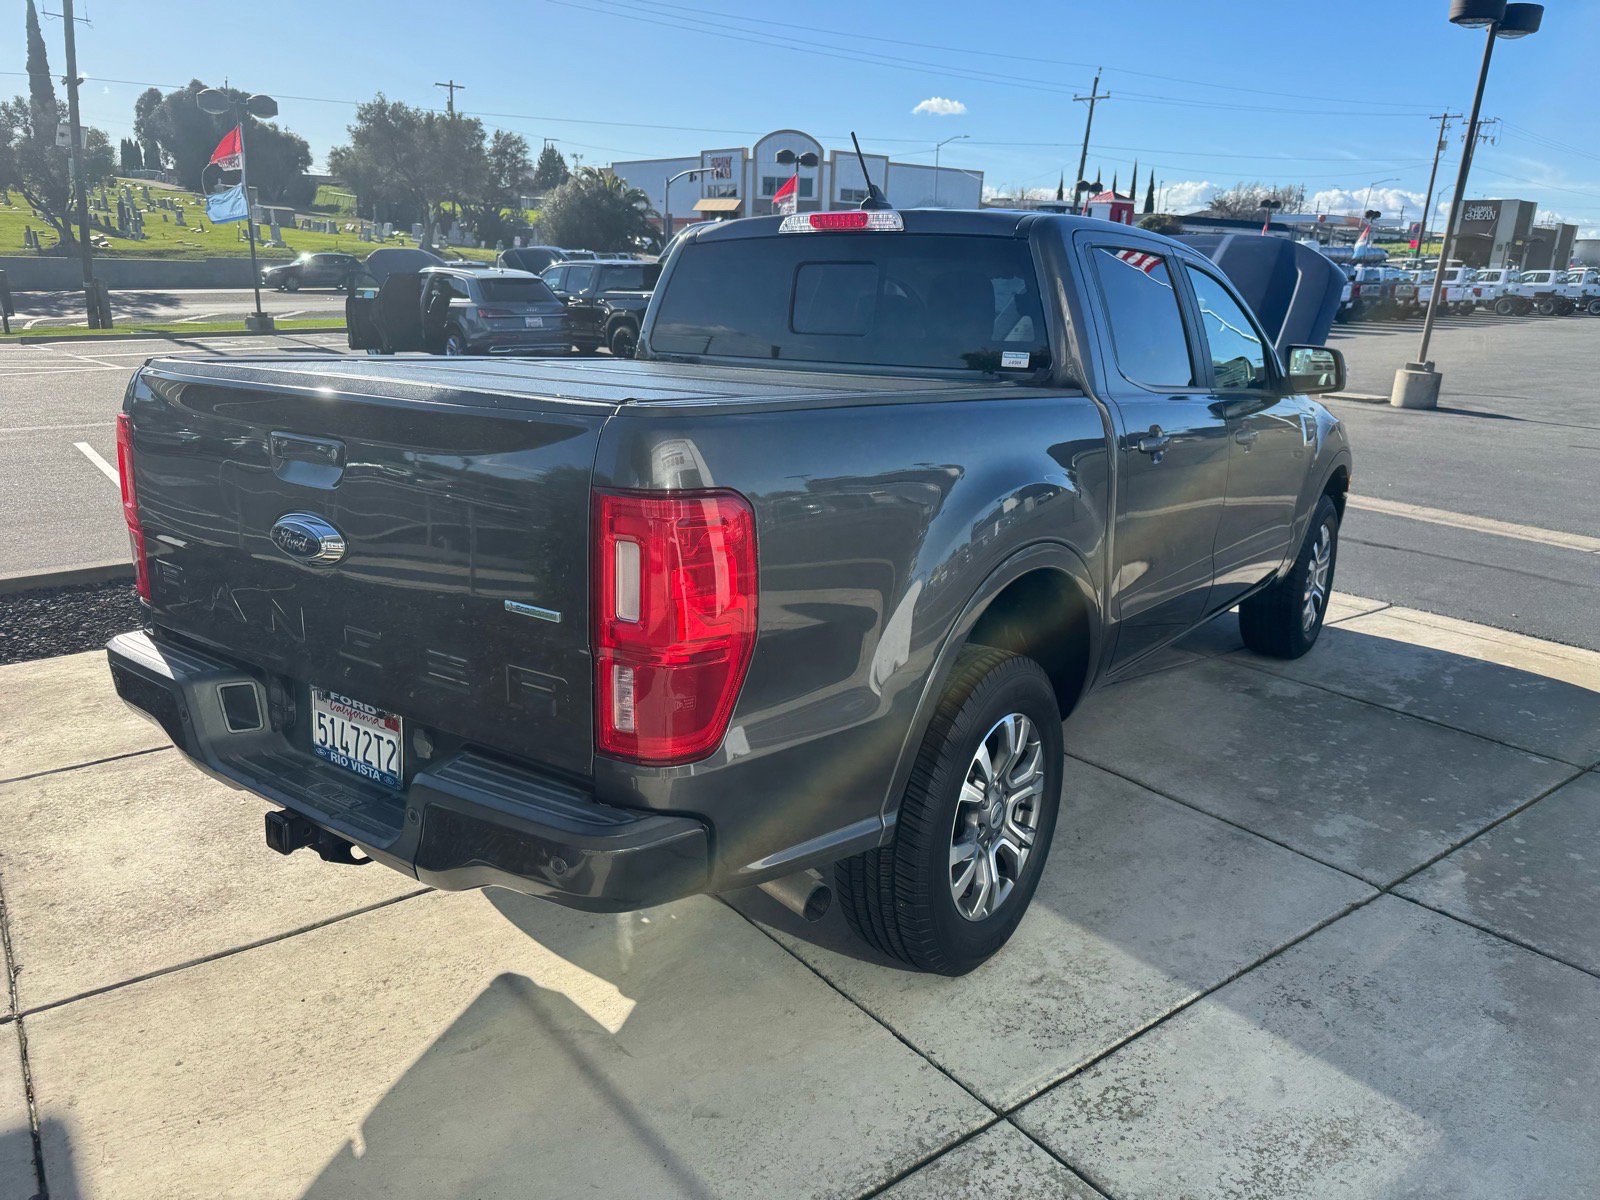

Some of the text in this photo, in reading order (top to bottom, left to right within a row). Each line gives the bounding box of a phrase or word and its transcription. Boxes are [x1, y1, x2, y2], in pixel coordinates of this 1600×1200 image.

[279, 526, 308, 552] Ford
[329, 691, 377, 715] FORD
[317, 711, 397, 776] 51472T2
[330, 751, 349, 767] RIO
[350, 761, 381, 782] VISTA
